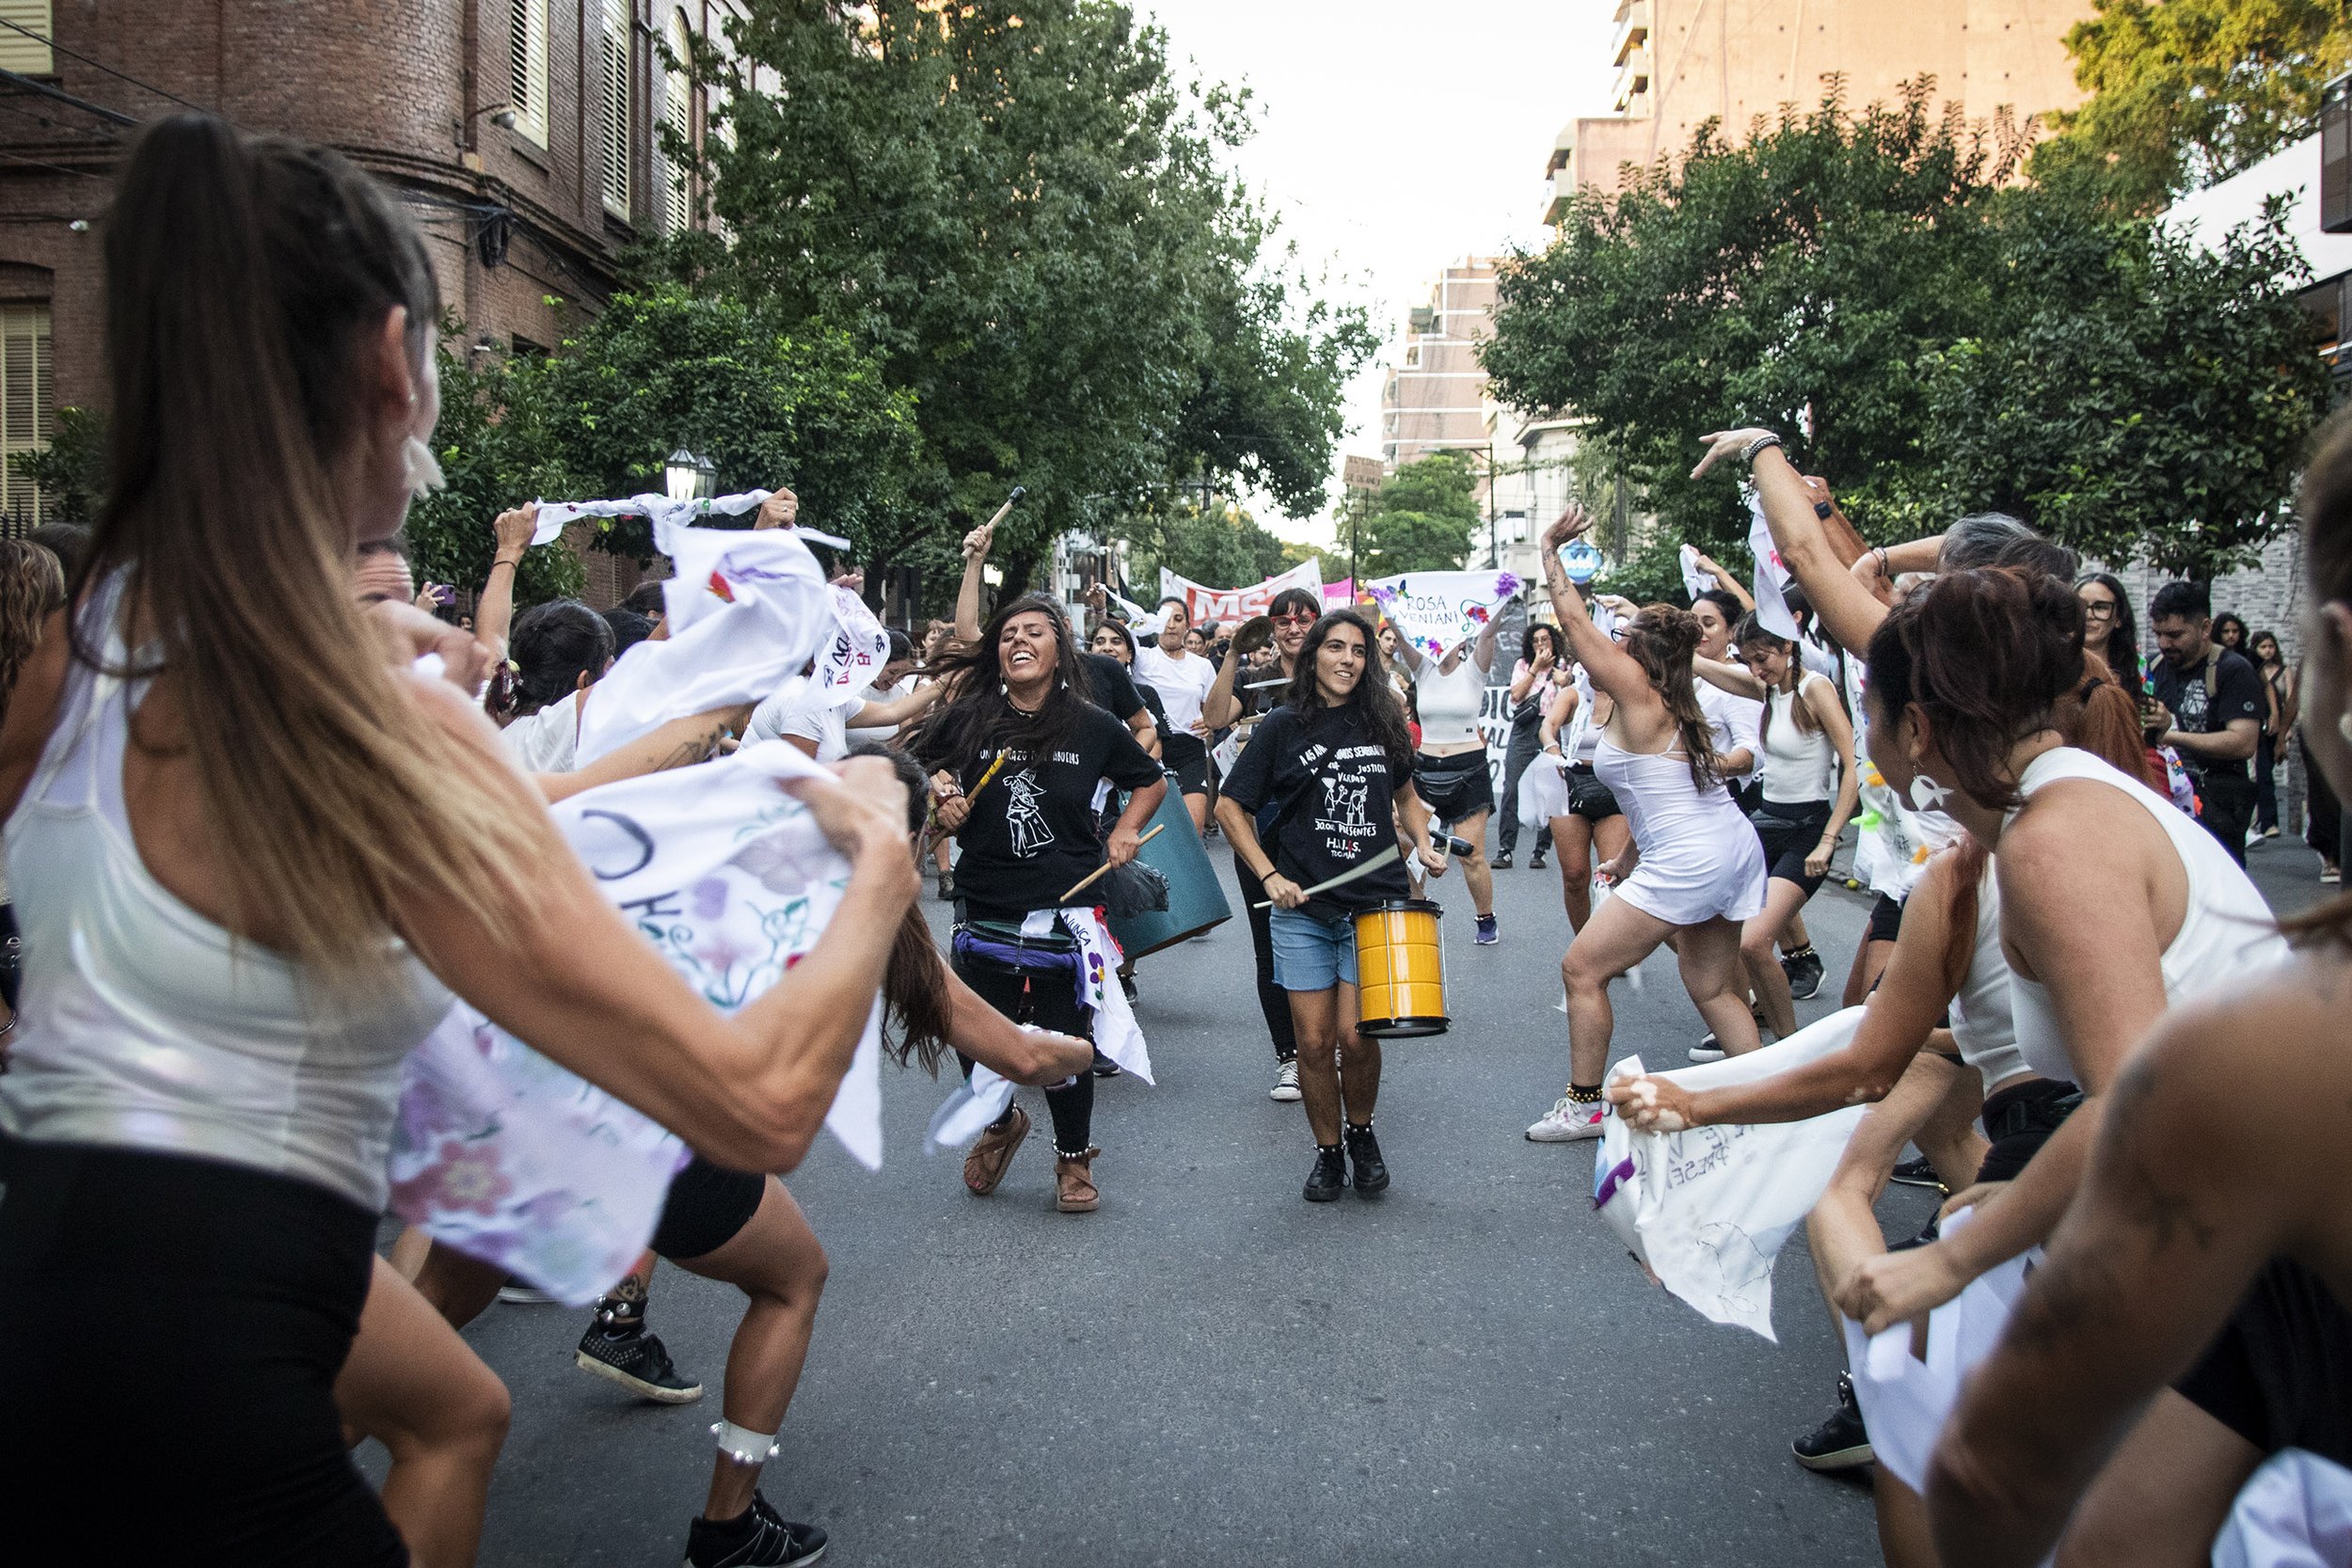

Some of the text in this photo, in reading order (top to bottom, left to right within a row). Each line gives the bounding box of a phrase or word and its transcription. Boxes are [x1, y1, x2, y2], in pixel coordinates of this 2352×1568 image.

[1406, 595, 1447, 610] ROSA
[1337, 771, 1367, 784] VERDAD
[1063, 912, 1091, 948] NUNCA
